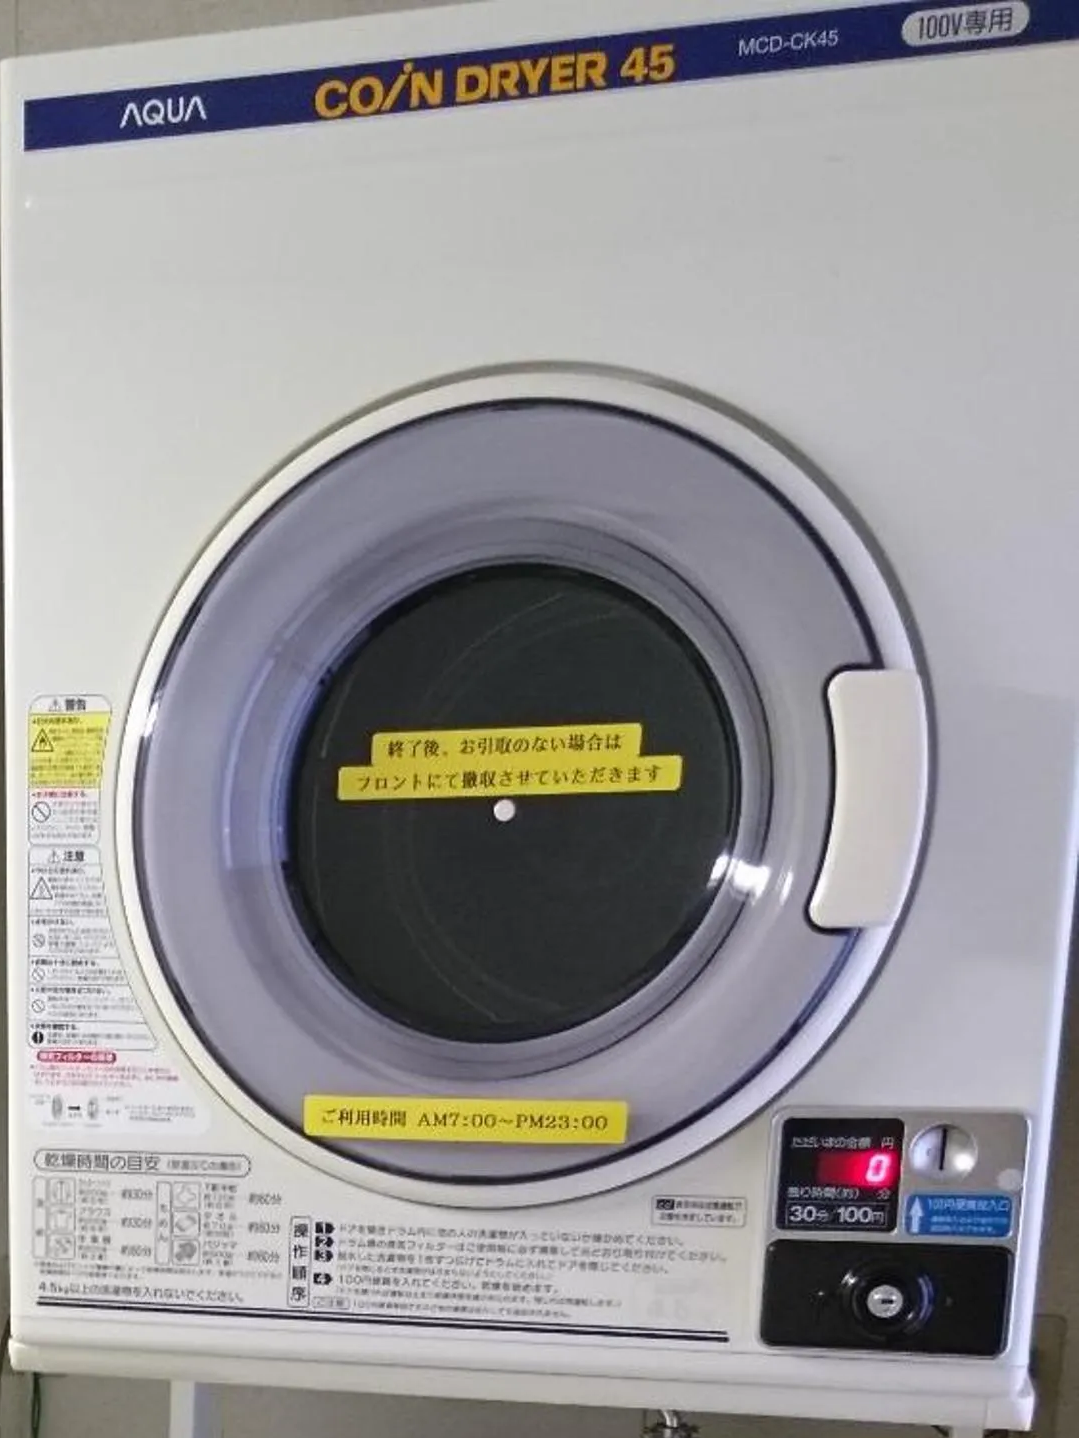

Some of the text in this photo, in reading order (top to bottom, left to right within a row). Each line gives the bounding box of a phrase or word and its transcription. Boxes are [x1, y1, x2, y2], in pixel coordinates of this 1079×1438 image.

[738, 30, 838, 57] MCD-CK45
[455, 52, 607, 105] DRYER
[619, 43, 675, 83] 45
[120, 96, 207, 128] AQUA
[321, 1107, 407, 1129] ご利用時間
[864, 1153, 892, 1183] 0
